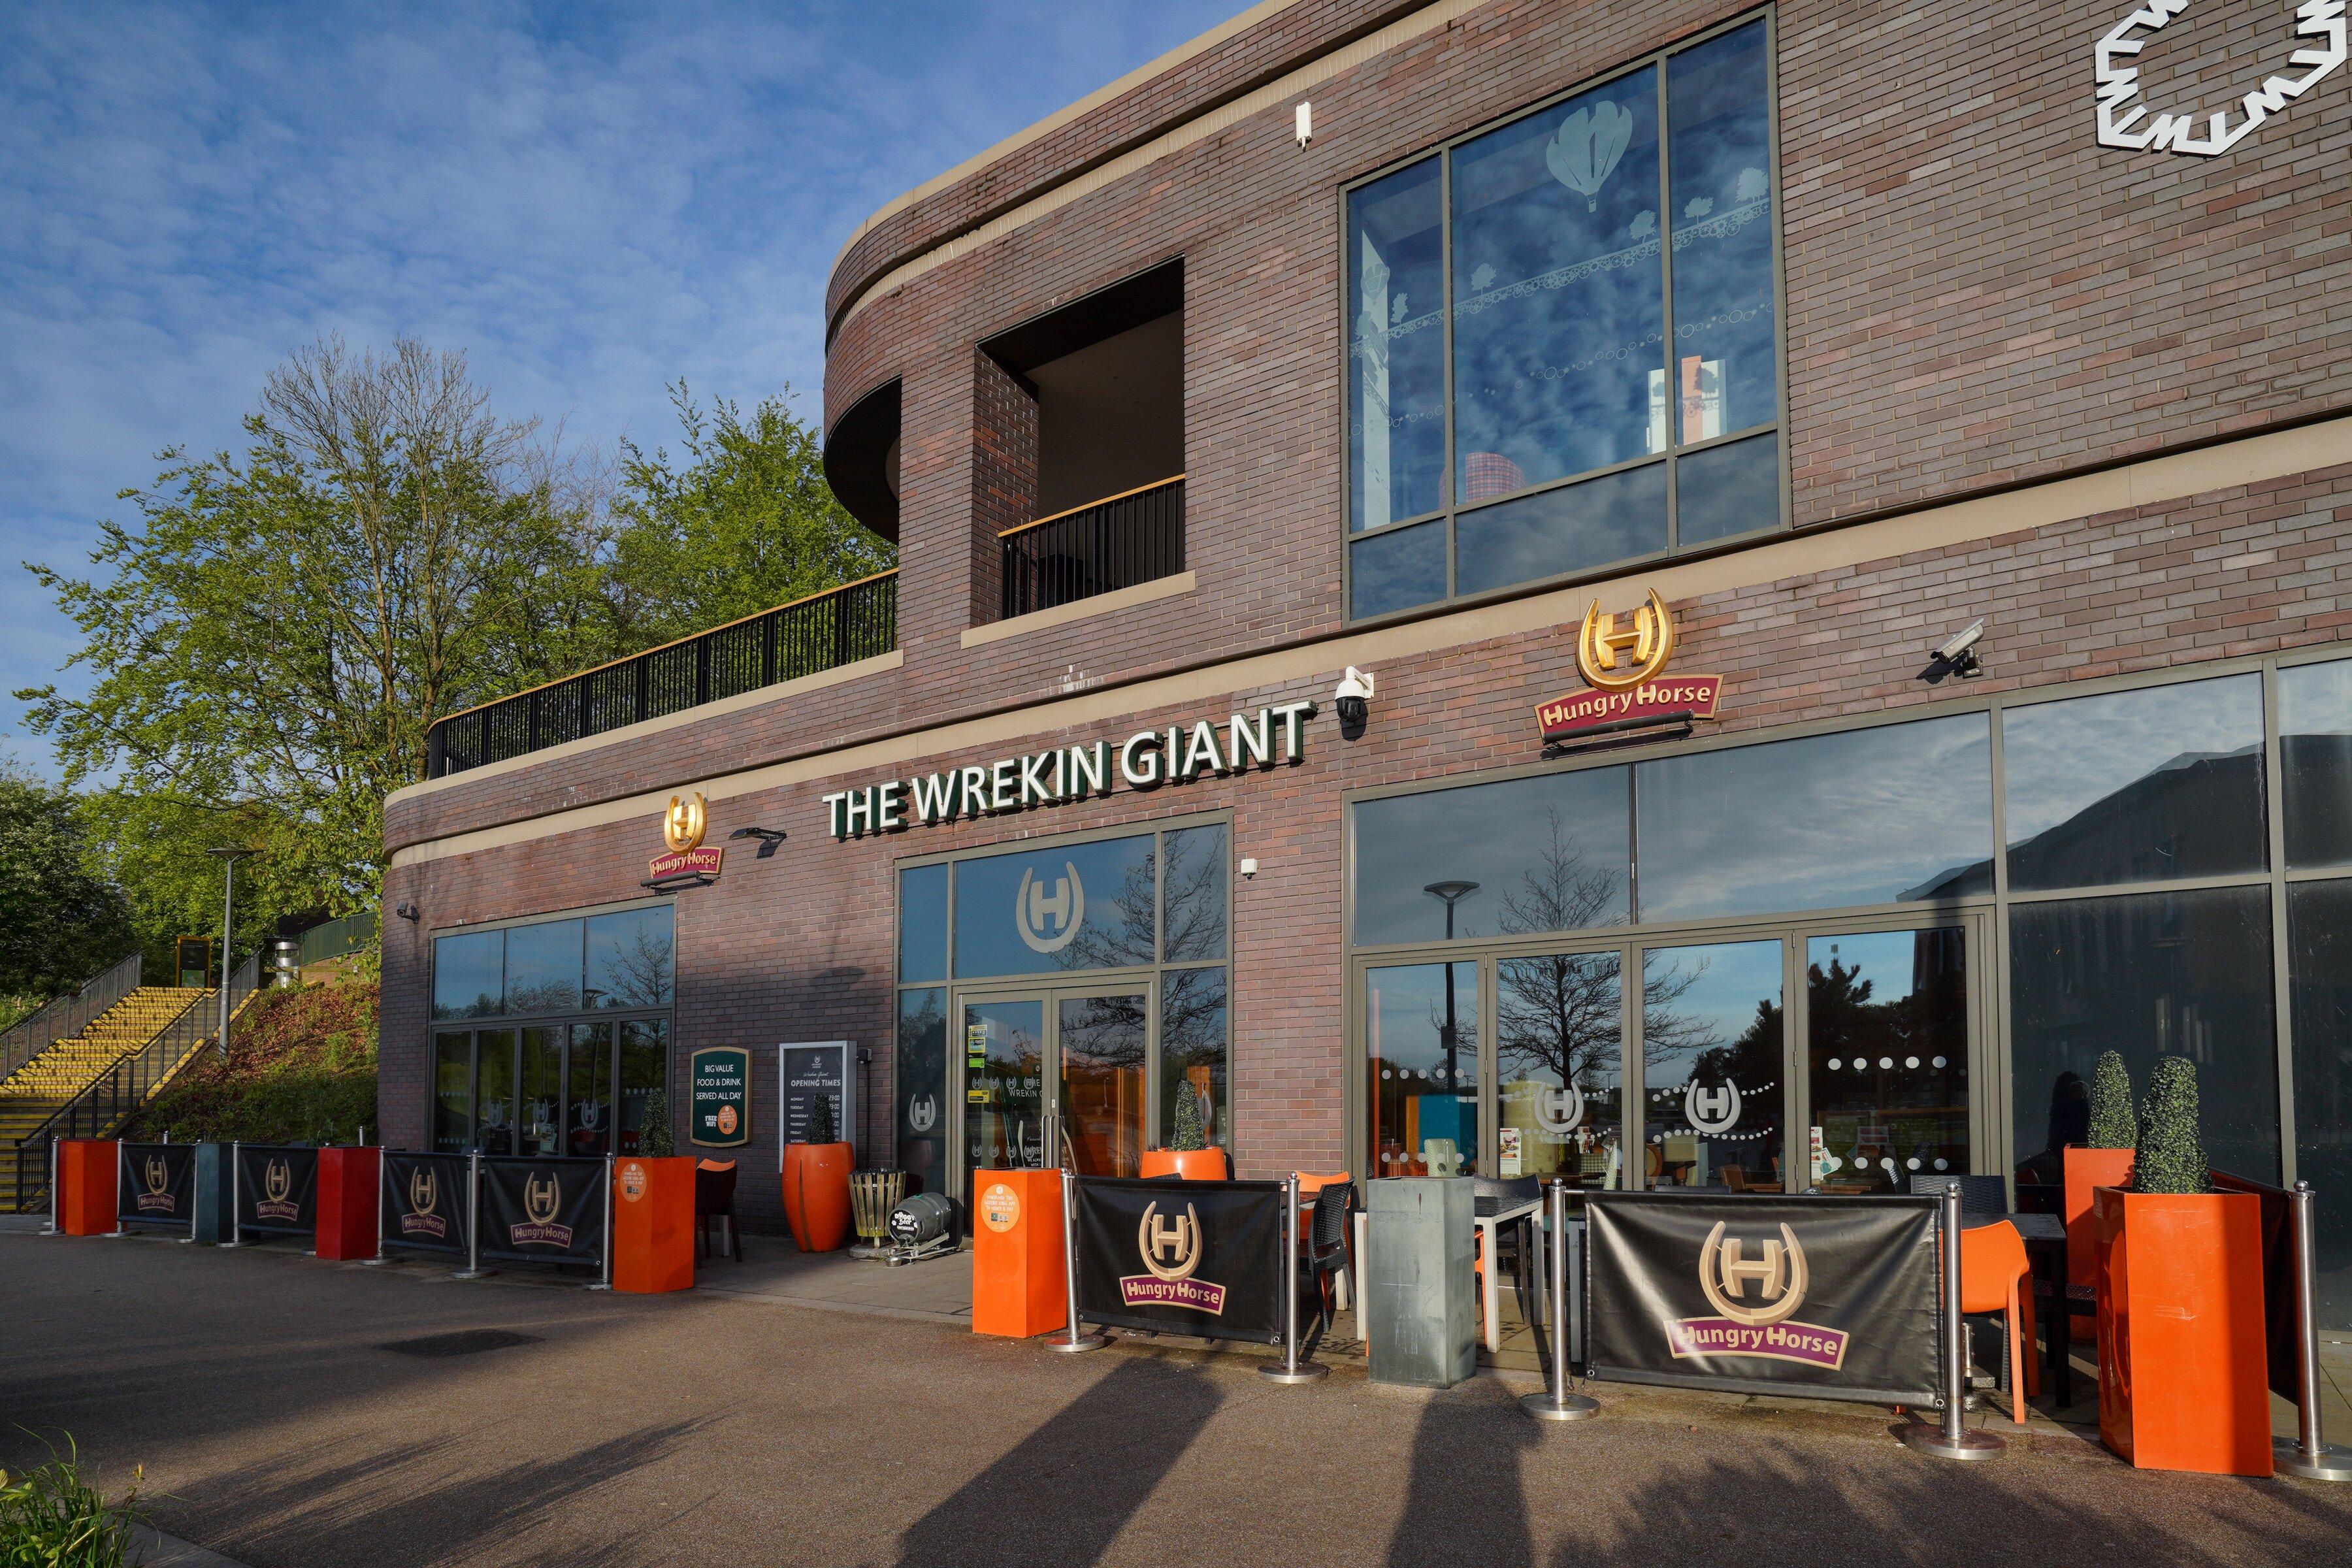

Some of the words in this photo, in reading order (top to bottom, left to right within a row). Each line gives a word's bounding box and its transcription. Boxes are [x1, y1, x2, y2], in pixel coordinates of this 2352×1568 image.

[1543, 691, 1633, 727] Hungry
[1636, 685, 1710, 705] Horse
[823, 780, 907, 837] THE
[911, 740, 1110, 823] WREKIN
[1121, 700, 1317, 785] GIANT
[651, 857, 687, 875] Hungry
[687, 852, 717, 864] Horse
[1008, 1089, 1037, 1098] WREKIN
[140, 1197, 160, 1208] Hungry
[160, 1196, 173, 1207] Horse
[259, 1205, 280, 1215] Hungry
[280, 1204, 297, 1215] Horse
[404, 1218, 425, 1230] Hungry
[425, 1218, 444, 1231] Horse
[515, 1228, 546, 1241] Hungry
[546, 1227, 569, 1241] Horse
[1126, 1281, 1176, 1299] Hungry
[1177, 1282, 1219, 1304] Horse
[1676, 1326, 1764, 1349] Hungry
[1766, 1327, 1838, 1356] Horse
